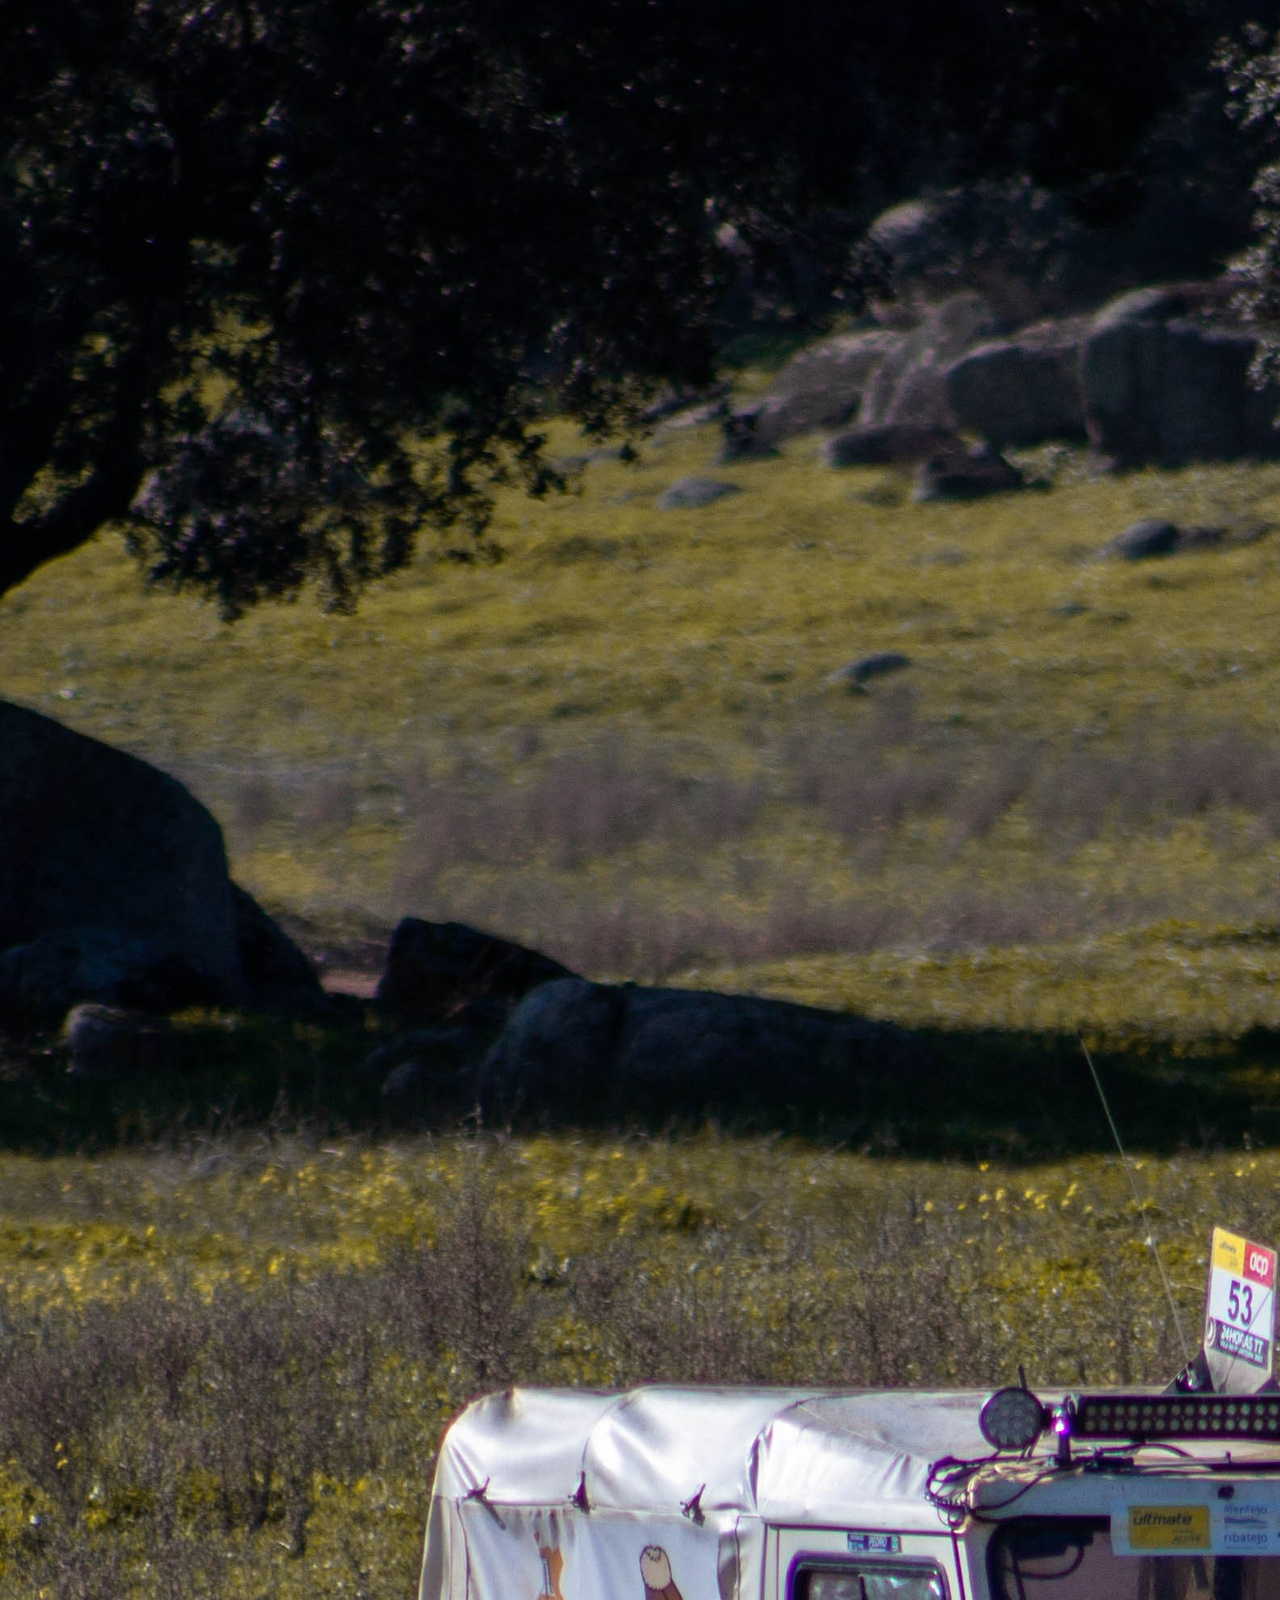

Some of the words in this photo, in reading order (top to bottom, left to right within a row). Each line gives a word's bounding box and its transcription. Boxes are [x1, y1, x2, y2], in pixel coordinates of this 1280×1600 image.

[1250, 1252, 1268, 1277] acp
[1228, 1280, 1253, 1326] 53
[1133, 1512, 1192, 1525] ultimate
[1224, 1532, 1267, 1545] ribatejo
